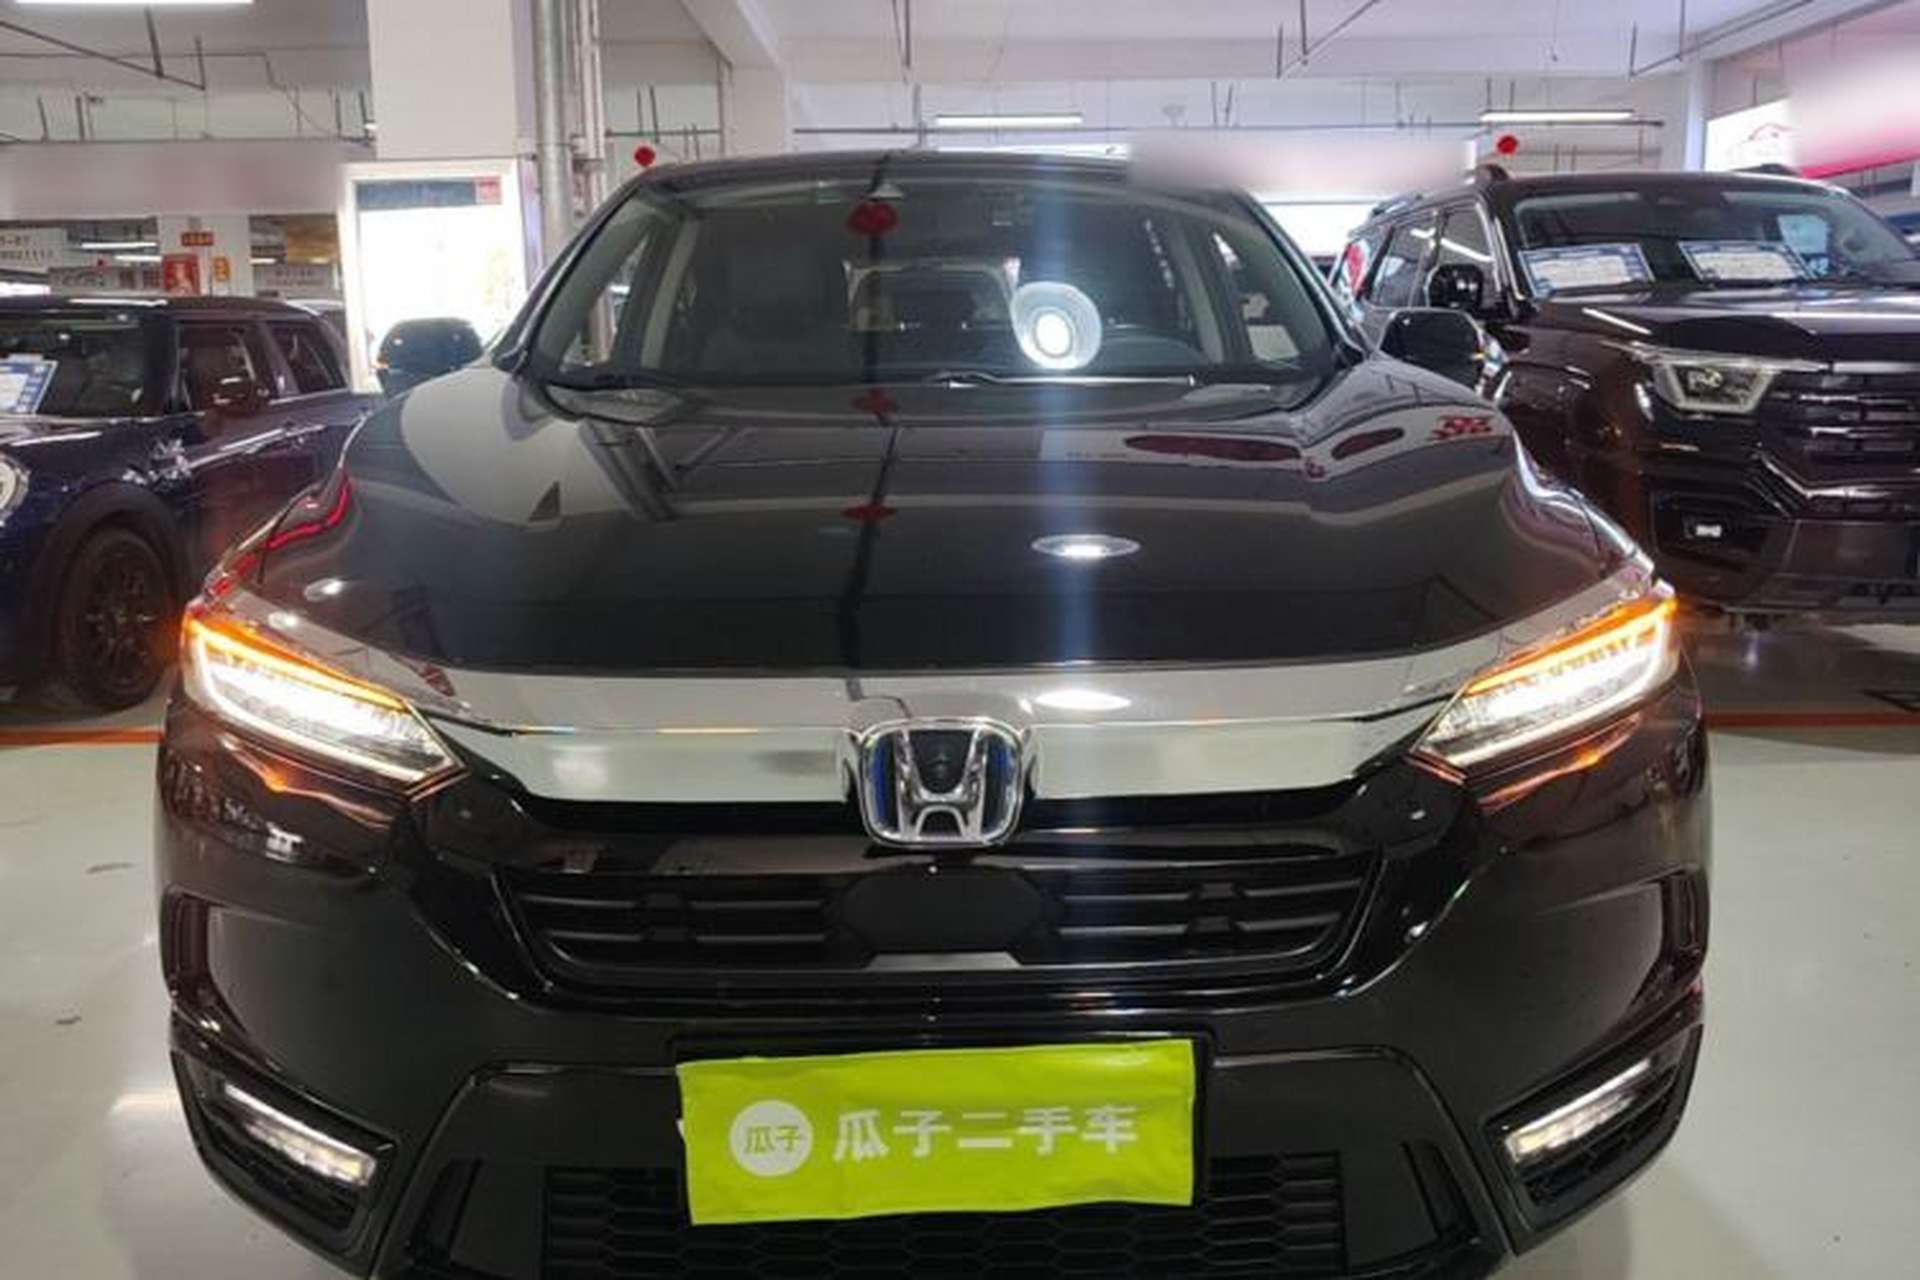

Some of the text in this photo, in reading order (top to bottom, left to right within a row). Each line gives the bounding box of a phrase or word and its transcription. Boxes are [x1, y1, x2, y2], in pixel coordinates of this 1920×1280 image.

[743, 1125, 803, 1155] 瓜子
[832, 1104, 1139, 1163] 瓜子二手车
